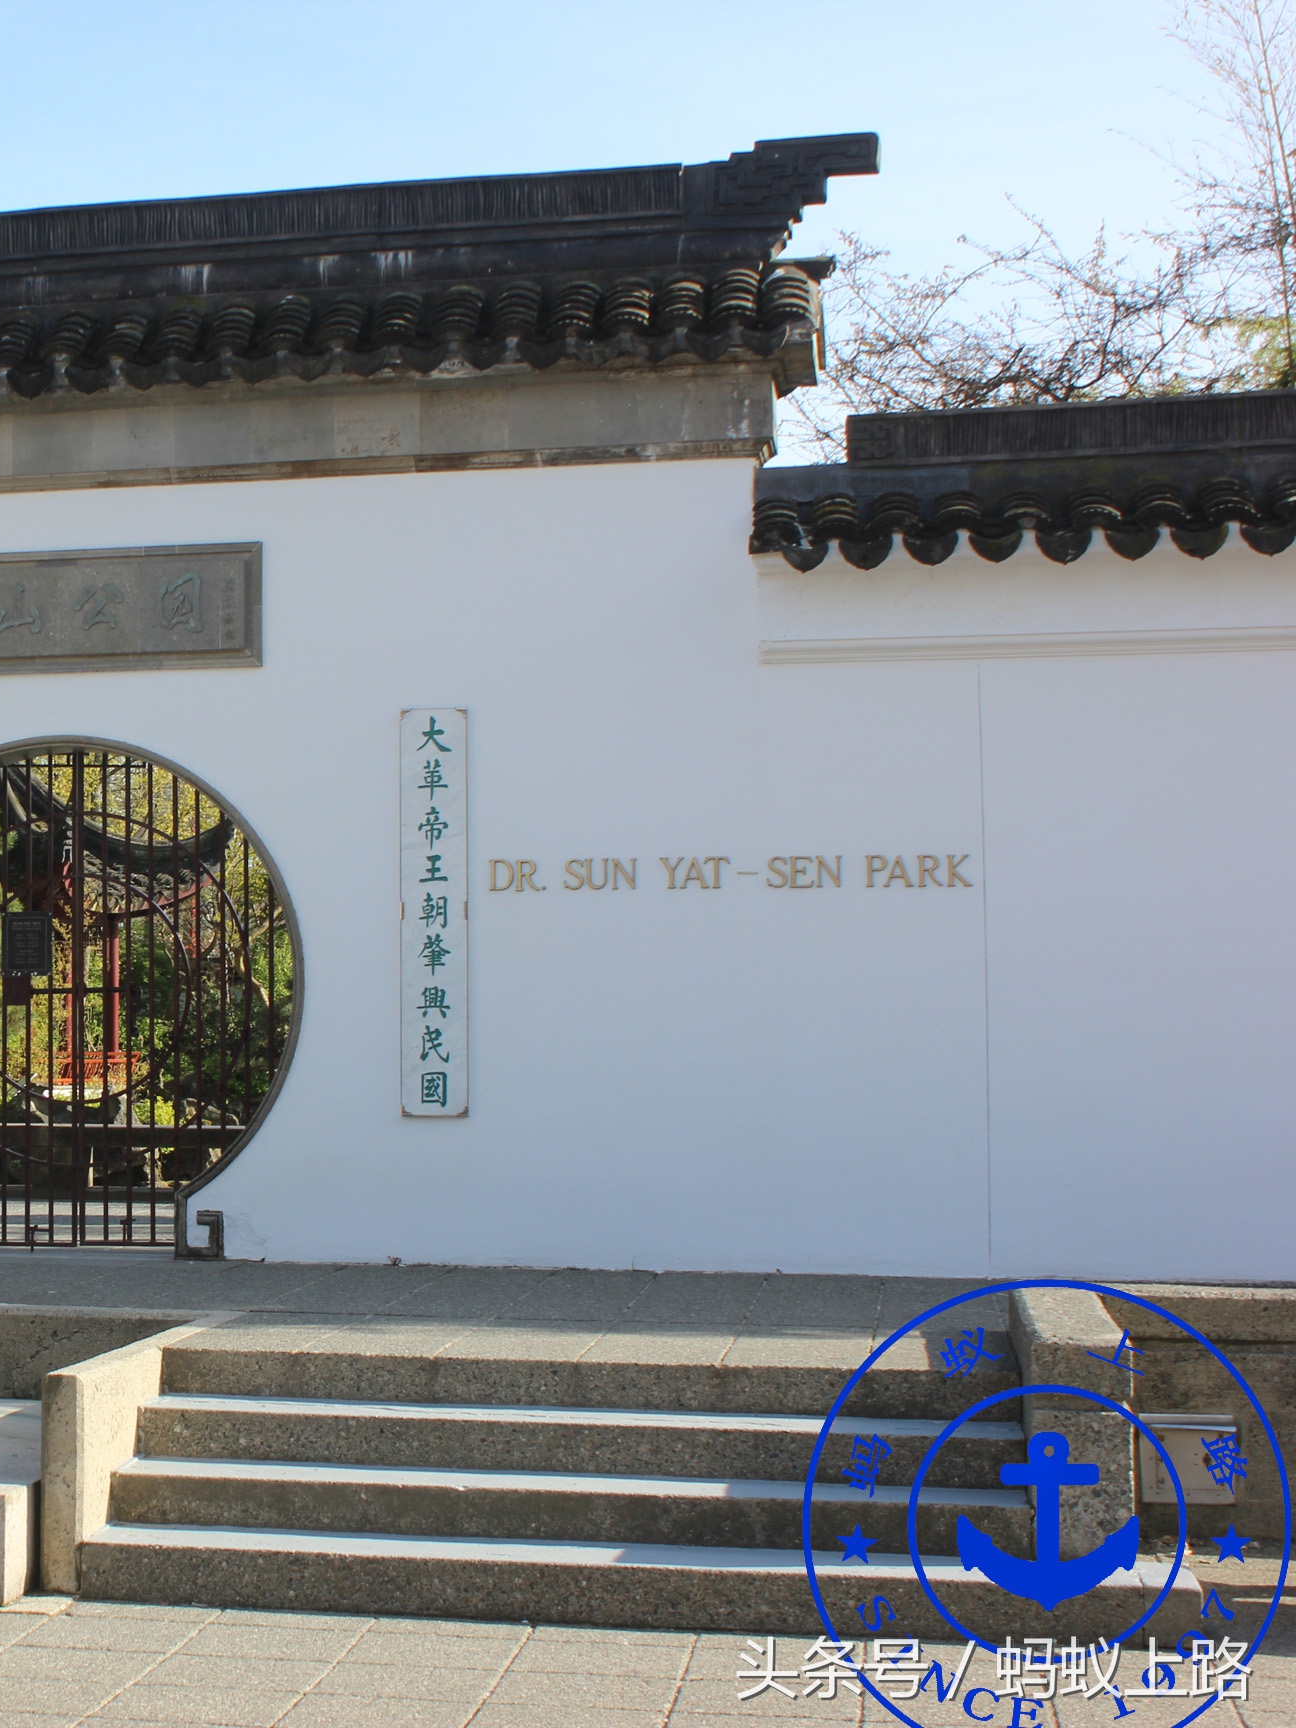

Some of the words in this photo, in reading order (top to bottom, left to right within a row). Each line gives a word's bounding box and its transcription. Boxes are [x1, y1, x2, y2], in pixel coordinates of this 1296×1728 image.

[415, 715, 453, 1109] 大革帝王朝肇興民國
[488, 859, 547, 893] DR.
[563, 858, 637, 891] SUN
[864, 854, 974, 888] PARK
